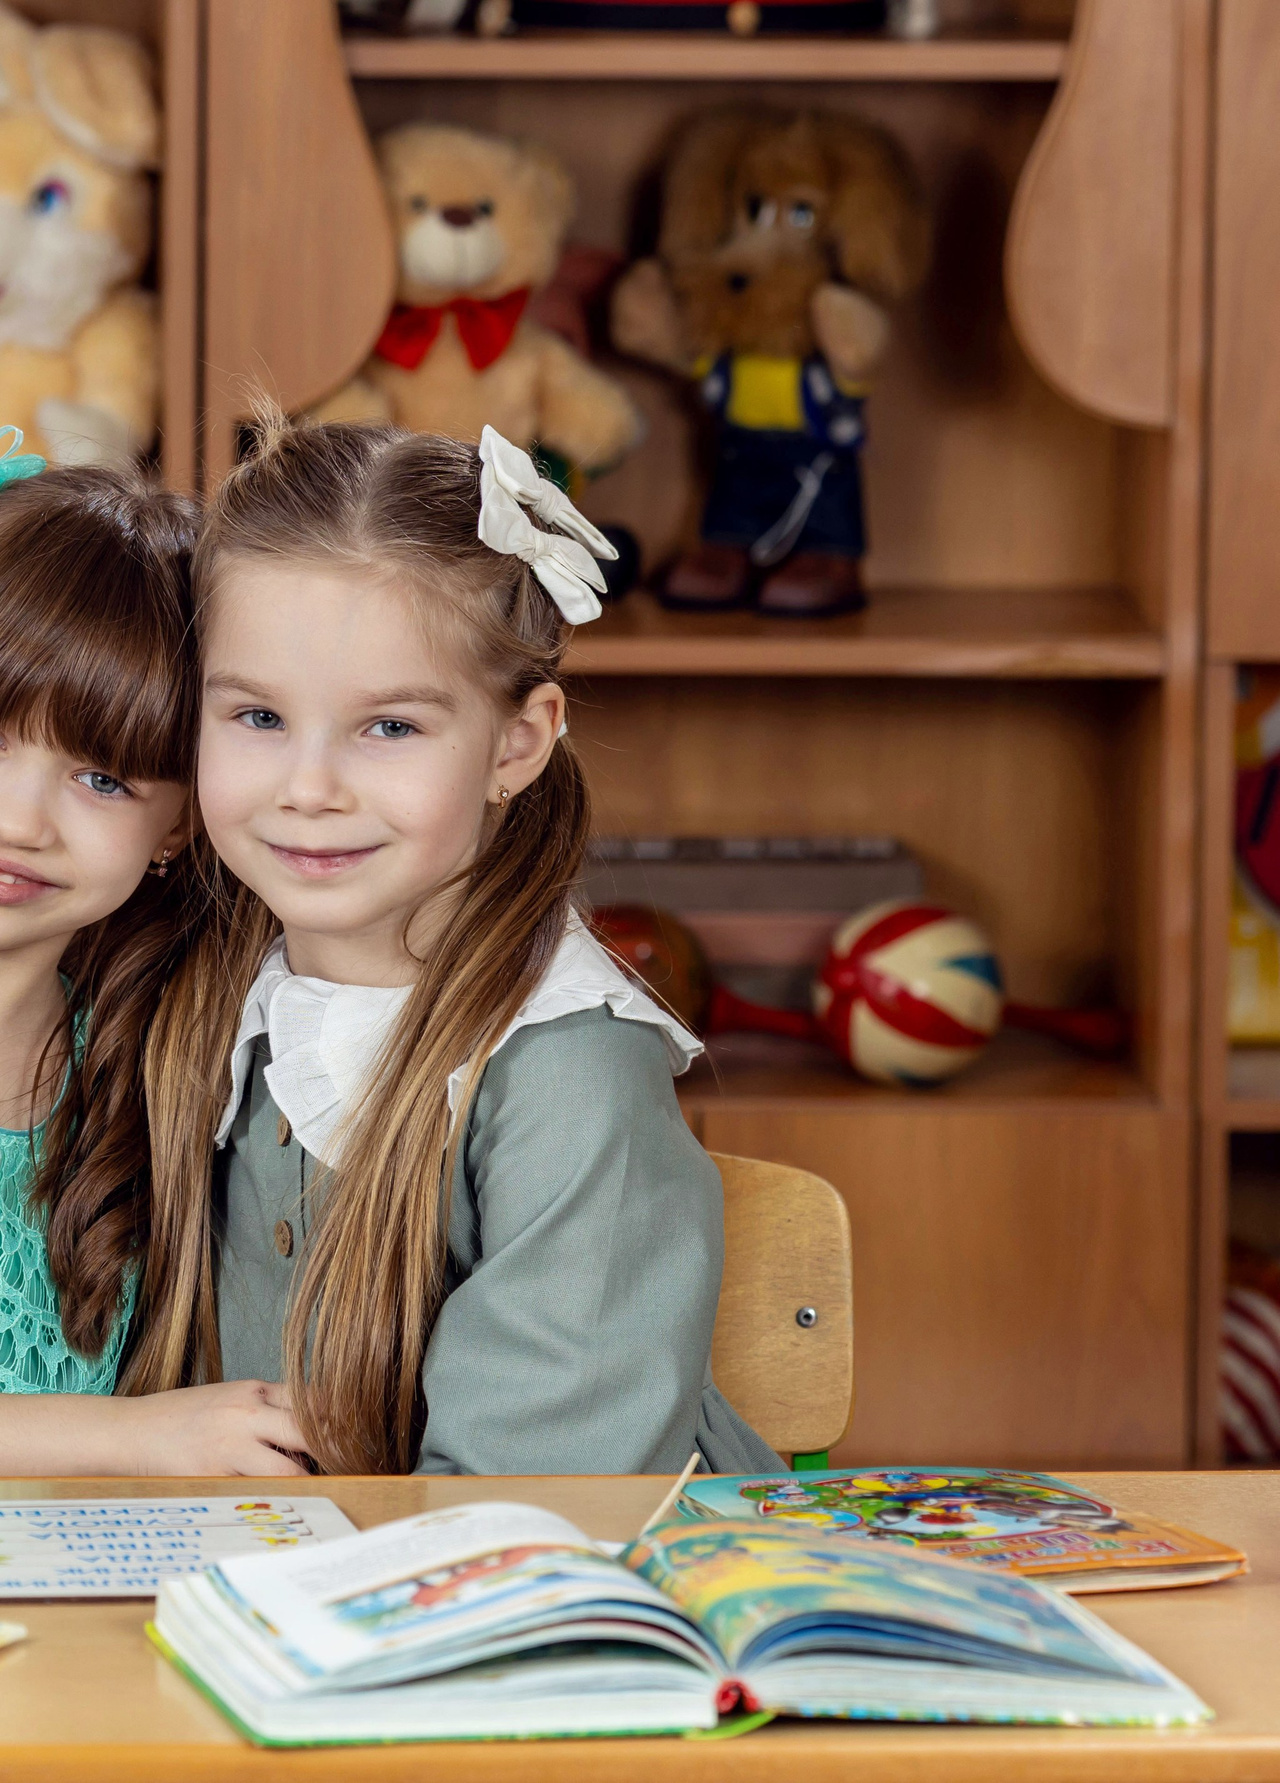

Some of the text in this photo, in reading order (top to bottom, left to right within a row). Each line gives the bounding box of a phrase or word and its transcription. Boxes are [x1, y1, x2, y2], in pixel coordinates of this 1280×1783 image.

[29, 1518, 194, 1528] СУББОТА
[28, 1529, 202, 1540] ПЯТНИЦА
[60, 1541, 200, 1552] ЧЕТВЕРГ
[77, 1553, 202, 1564] СРЕДА
[54, 1565, 208, 1576] ТОРНИК
